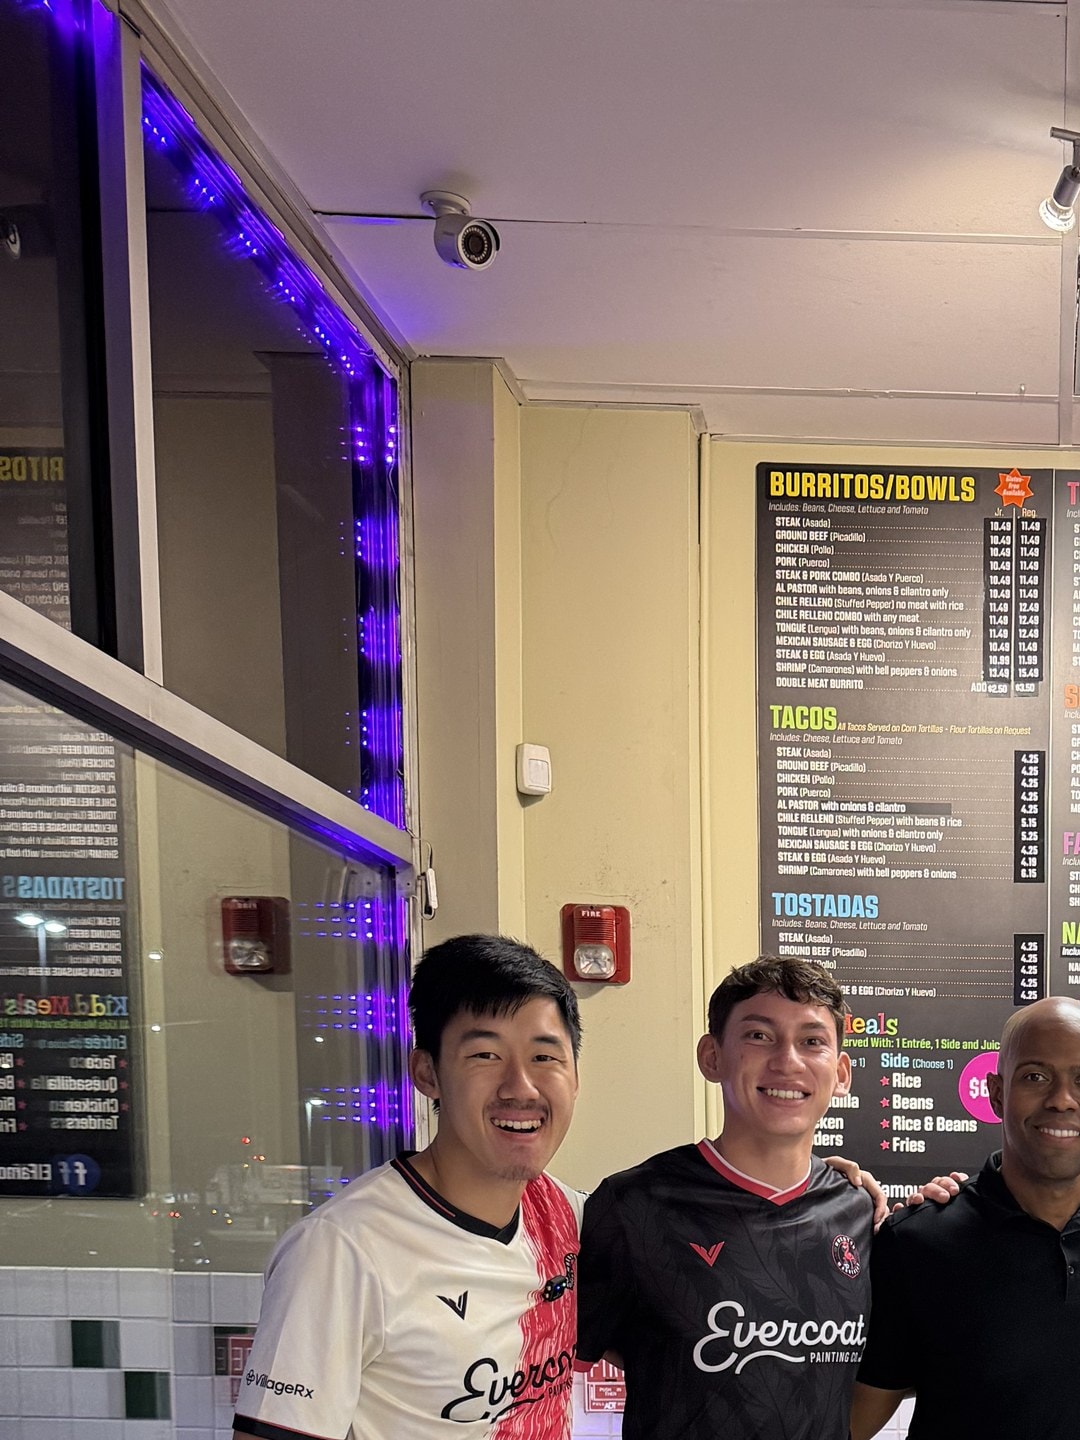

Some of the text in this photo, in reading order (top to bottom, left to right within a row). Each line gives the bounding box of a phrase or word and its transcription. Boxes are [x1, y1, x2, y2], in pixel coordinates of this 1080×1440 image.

[770, 472, 976, 502] BURRITOS/BOWLS
[776, 517, 831, 528] STEAK (Asada)
[990, 522, 1040, 531] 10.49 11.49
[776, 530, 866, 542] GROUND BEEF (Picadillo)
[990, 535, 1040, 545] 10.49 11.49
[776, 544, 834, 555] CHICKEN (Pollo)
[990, 547, 1039, 557] 10.49 11.49
[776, 557, 829, 568] PORK (Puerco)
[990, 561, 1039, 570] 10.49 11.49
[770, 705, 837, 730] TACOS
[777, 800, 905, 813] AL PASTOR with onions & cilantro
[772, 892, 878, 919] TOSTADAS
[845, 1013, 898, 1035] eals
[842, 1037, 1000, 1051] erved With: 1 Entrée, 1 Side and Juic
[881, 1053, 953, 1070] Side (Choose 1)
[893, 1073, 921, 1088] Rice
[893, 1094, 934, 1110] Beans
[893, 1116, 977, 1132] Rice & Beans
[893, 1137, 925, 1152] Fries
[693, 1301, 866, 1374] Evercoat
[810, 1352, 849, 1363] PAINTING
[254, 1373, 314, 1399] VillageRx
